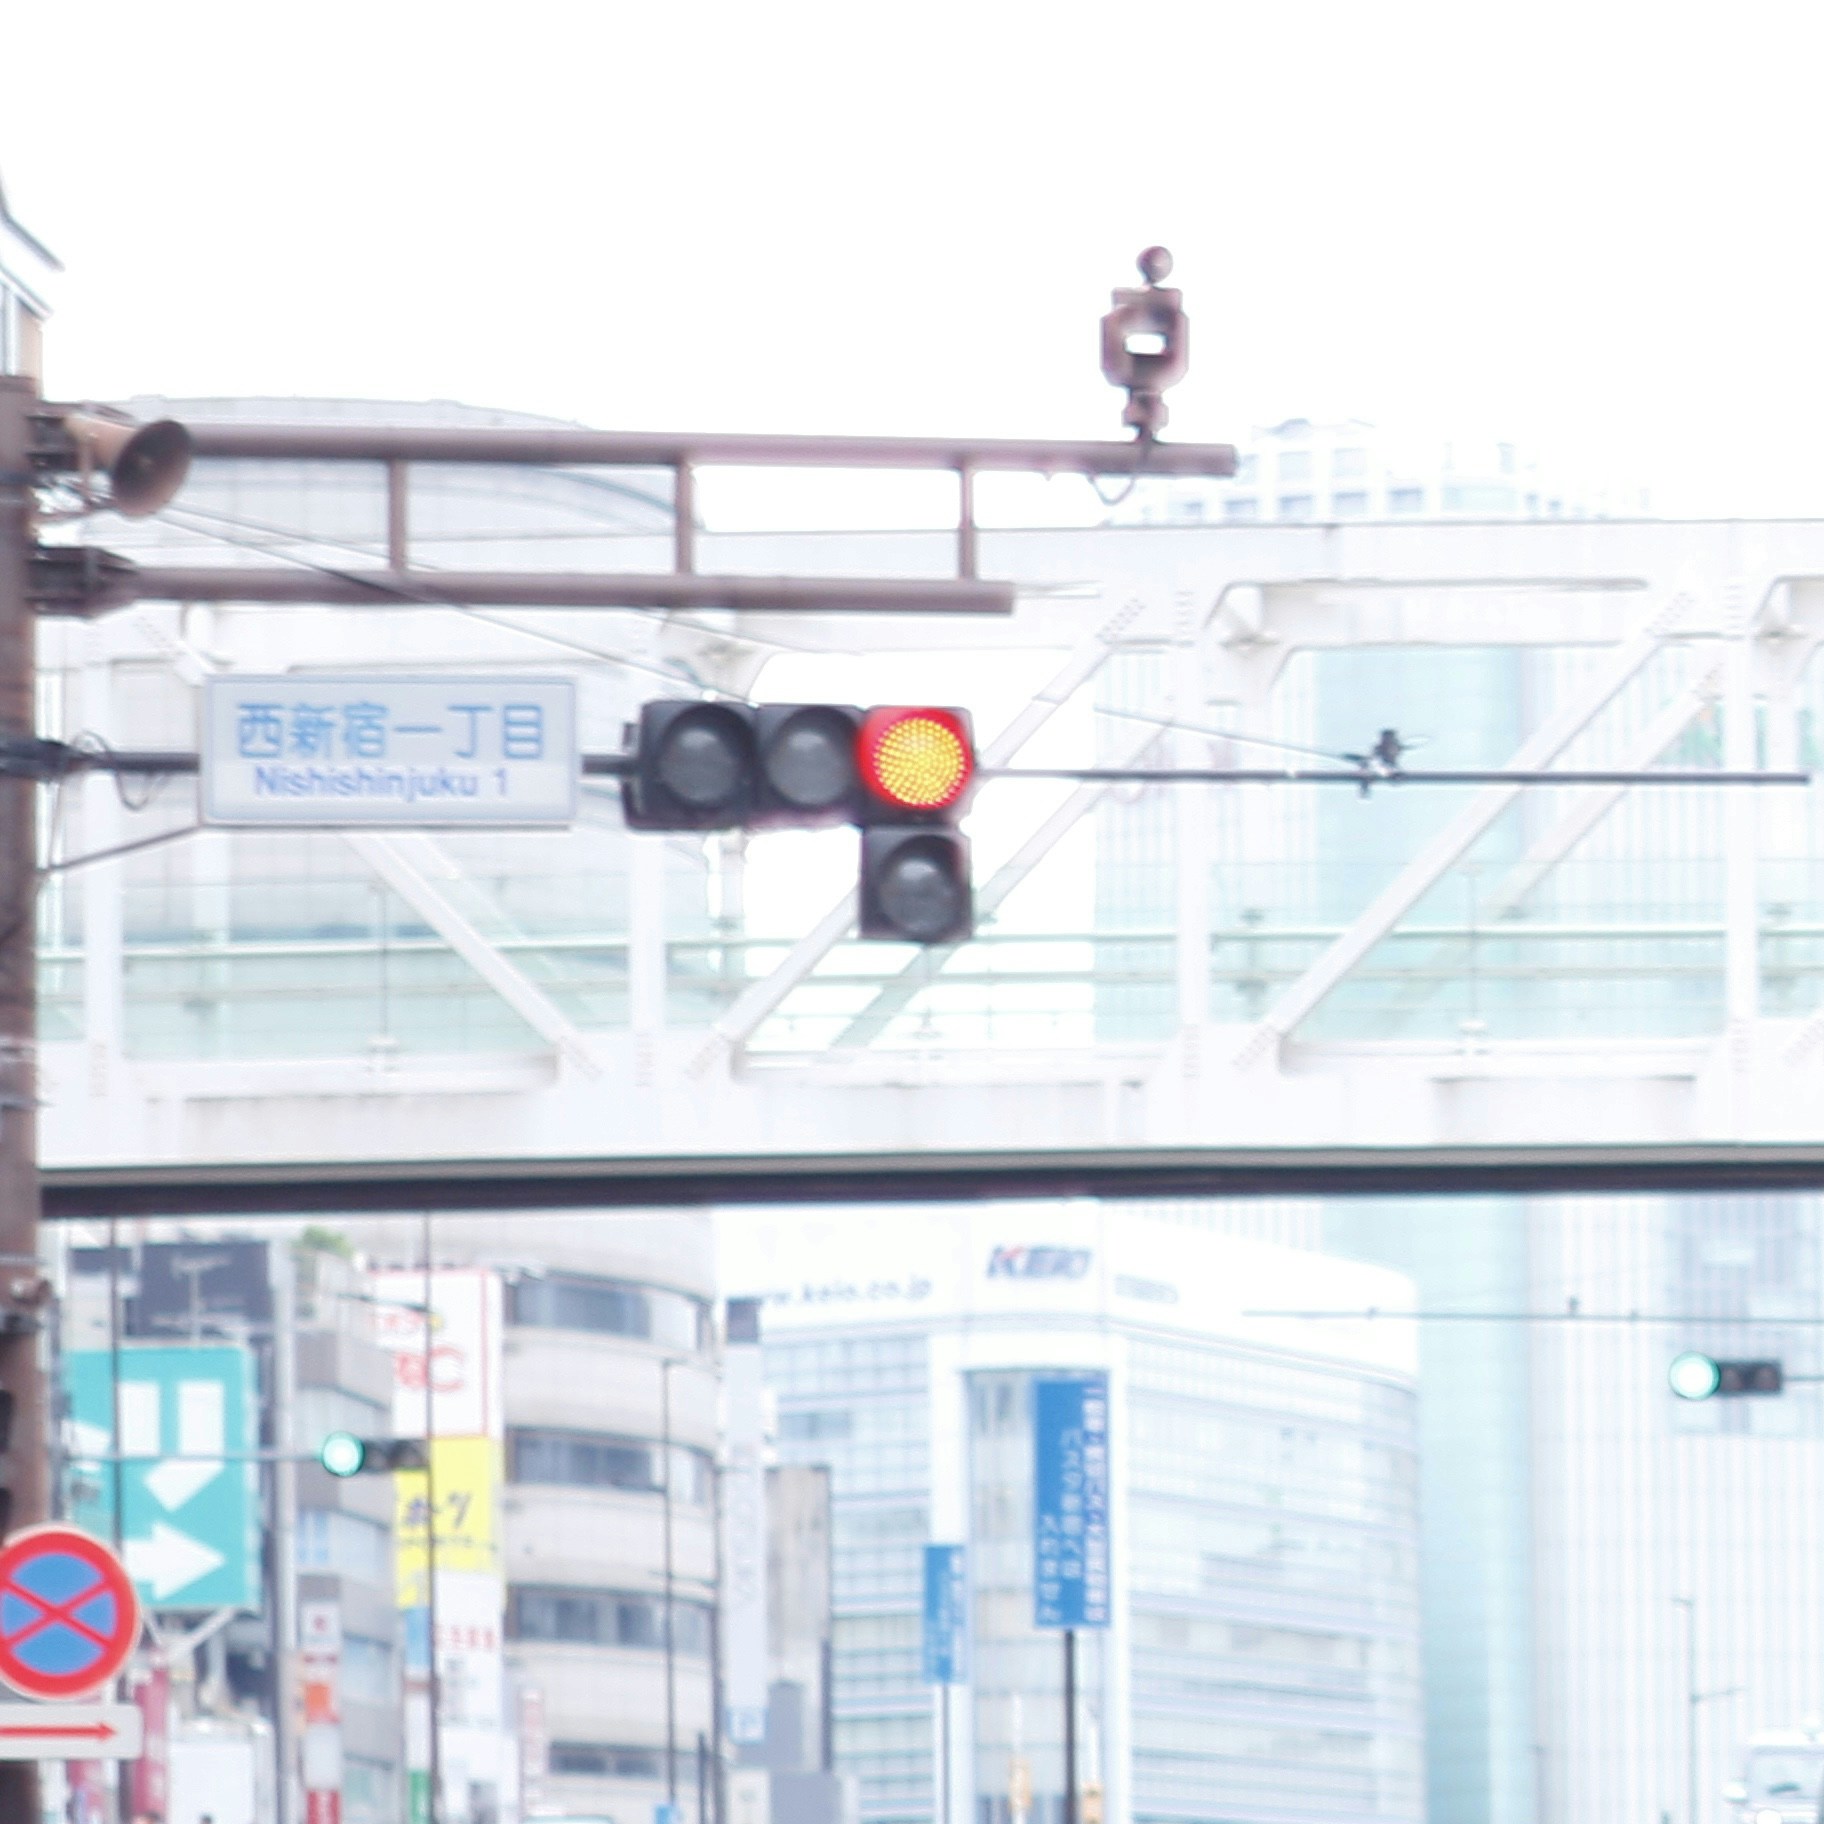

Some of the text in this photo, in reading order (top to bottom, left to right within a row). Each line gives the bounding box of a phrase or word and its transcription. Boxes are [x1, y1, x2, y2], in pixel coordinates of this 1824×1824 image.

[236, 700, 544, 760] 西新宿一丁目
[254, 764, 508, 802] Nishishinjuku 1
